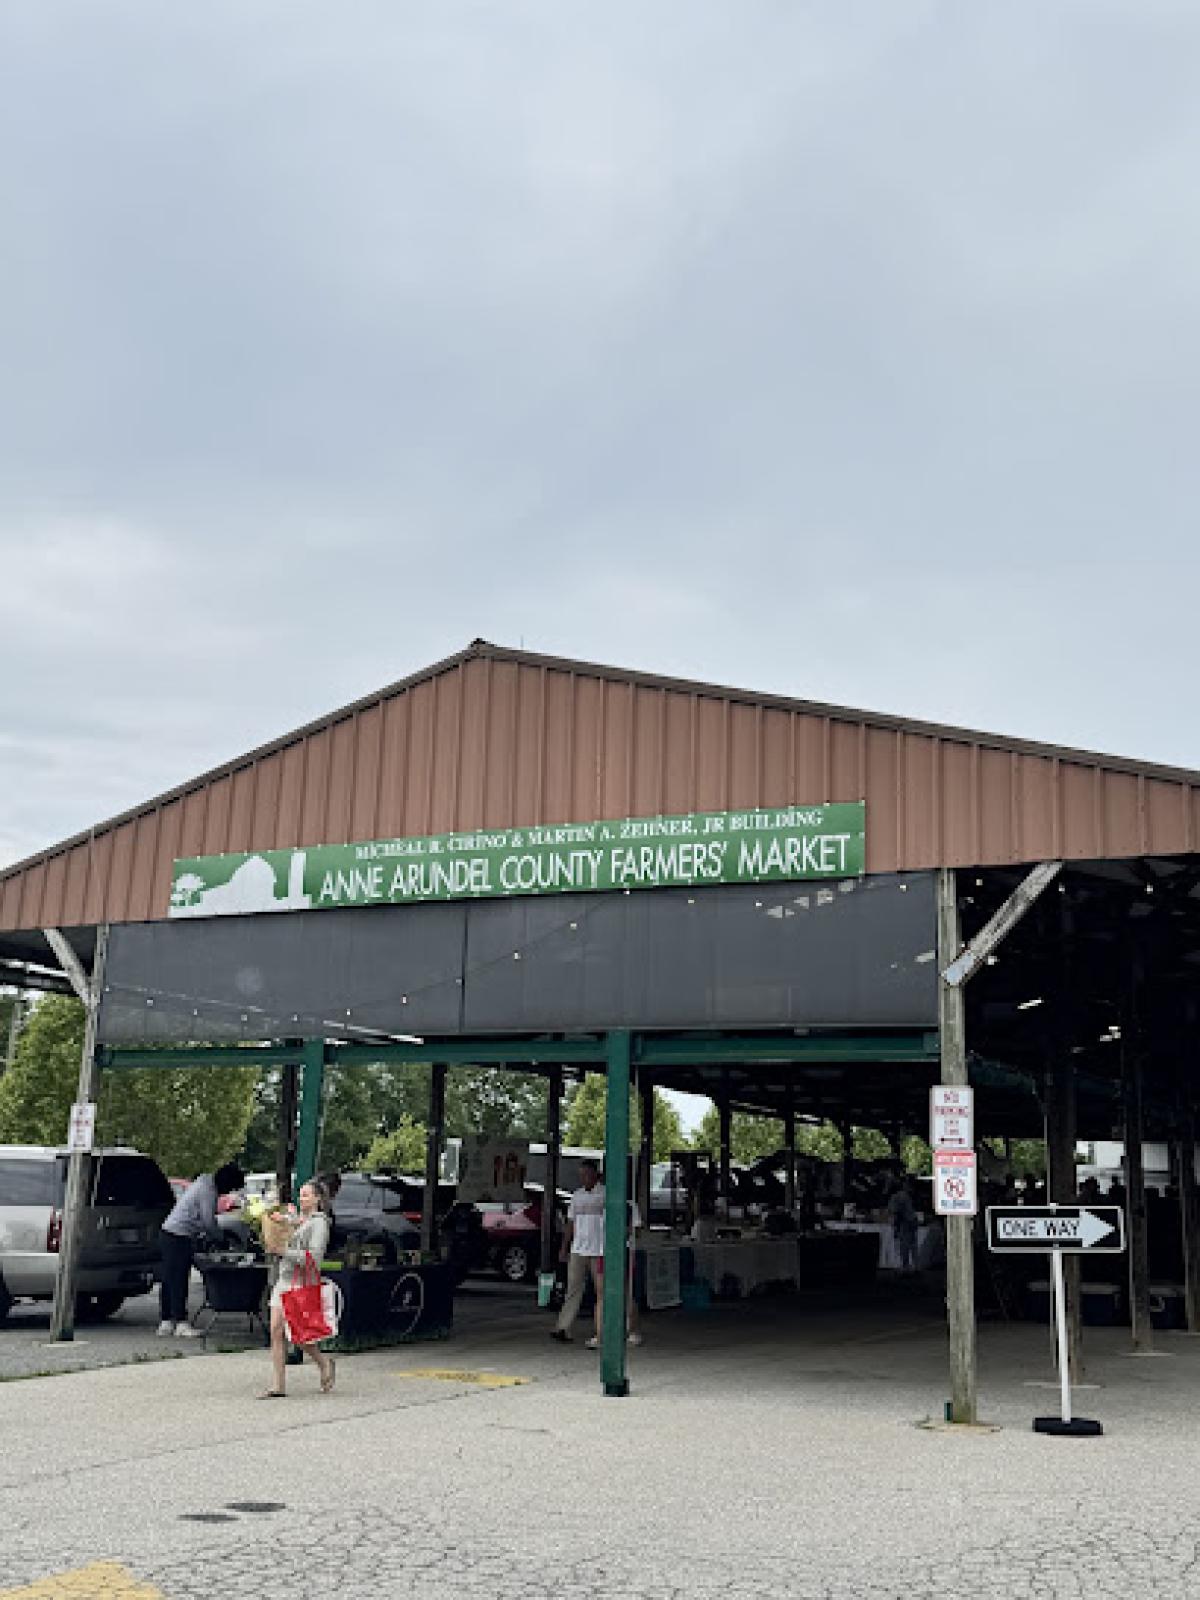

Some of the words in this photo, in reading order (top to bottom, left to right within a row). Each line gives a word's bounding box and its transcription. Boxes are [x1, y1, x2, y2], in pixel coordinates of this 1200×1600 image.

[447, 834, 507, 853] CIRINO
[511, 831, 524, 848] &
[528, 825, 595, 846] MARTIN
[600, 826, 616, 842] A.
[729, 809, 824, 831] BUILDING
[320, 864, 384, 902] ANNE
[388, 858, 493, 898] ARUNDEL
[500, 849, 604, 889] COUNTY
[611, 840, 728, 883] FARMERS'
[737, 833, 851, 877] MARKET
[1003, 1220, 1038, 1236] ONE
[1044, 1220, 1080, 1236] WAY
